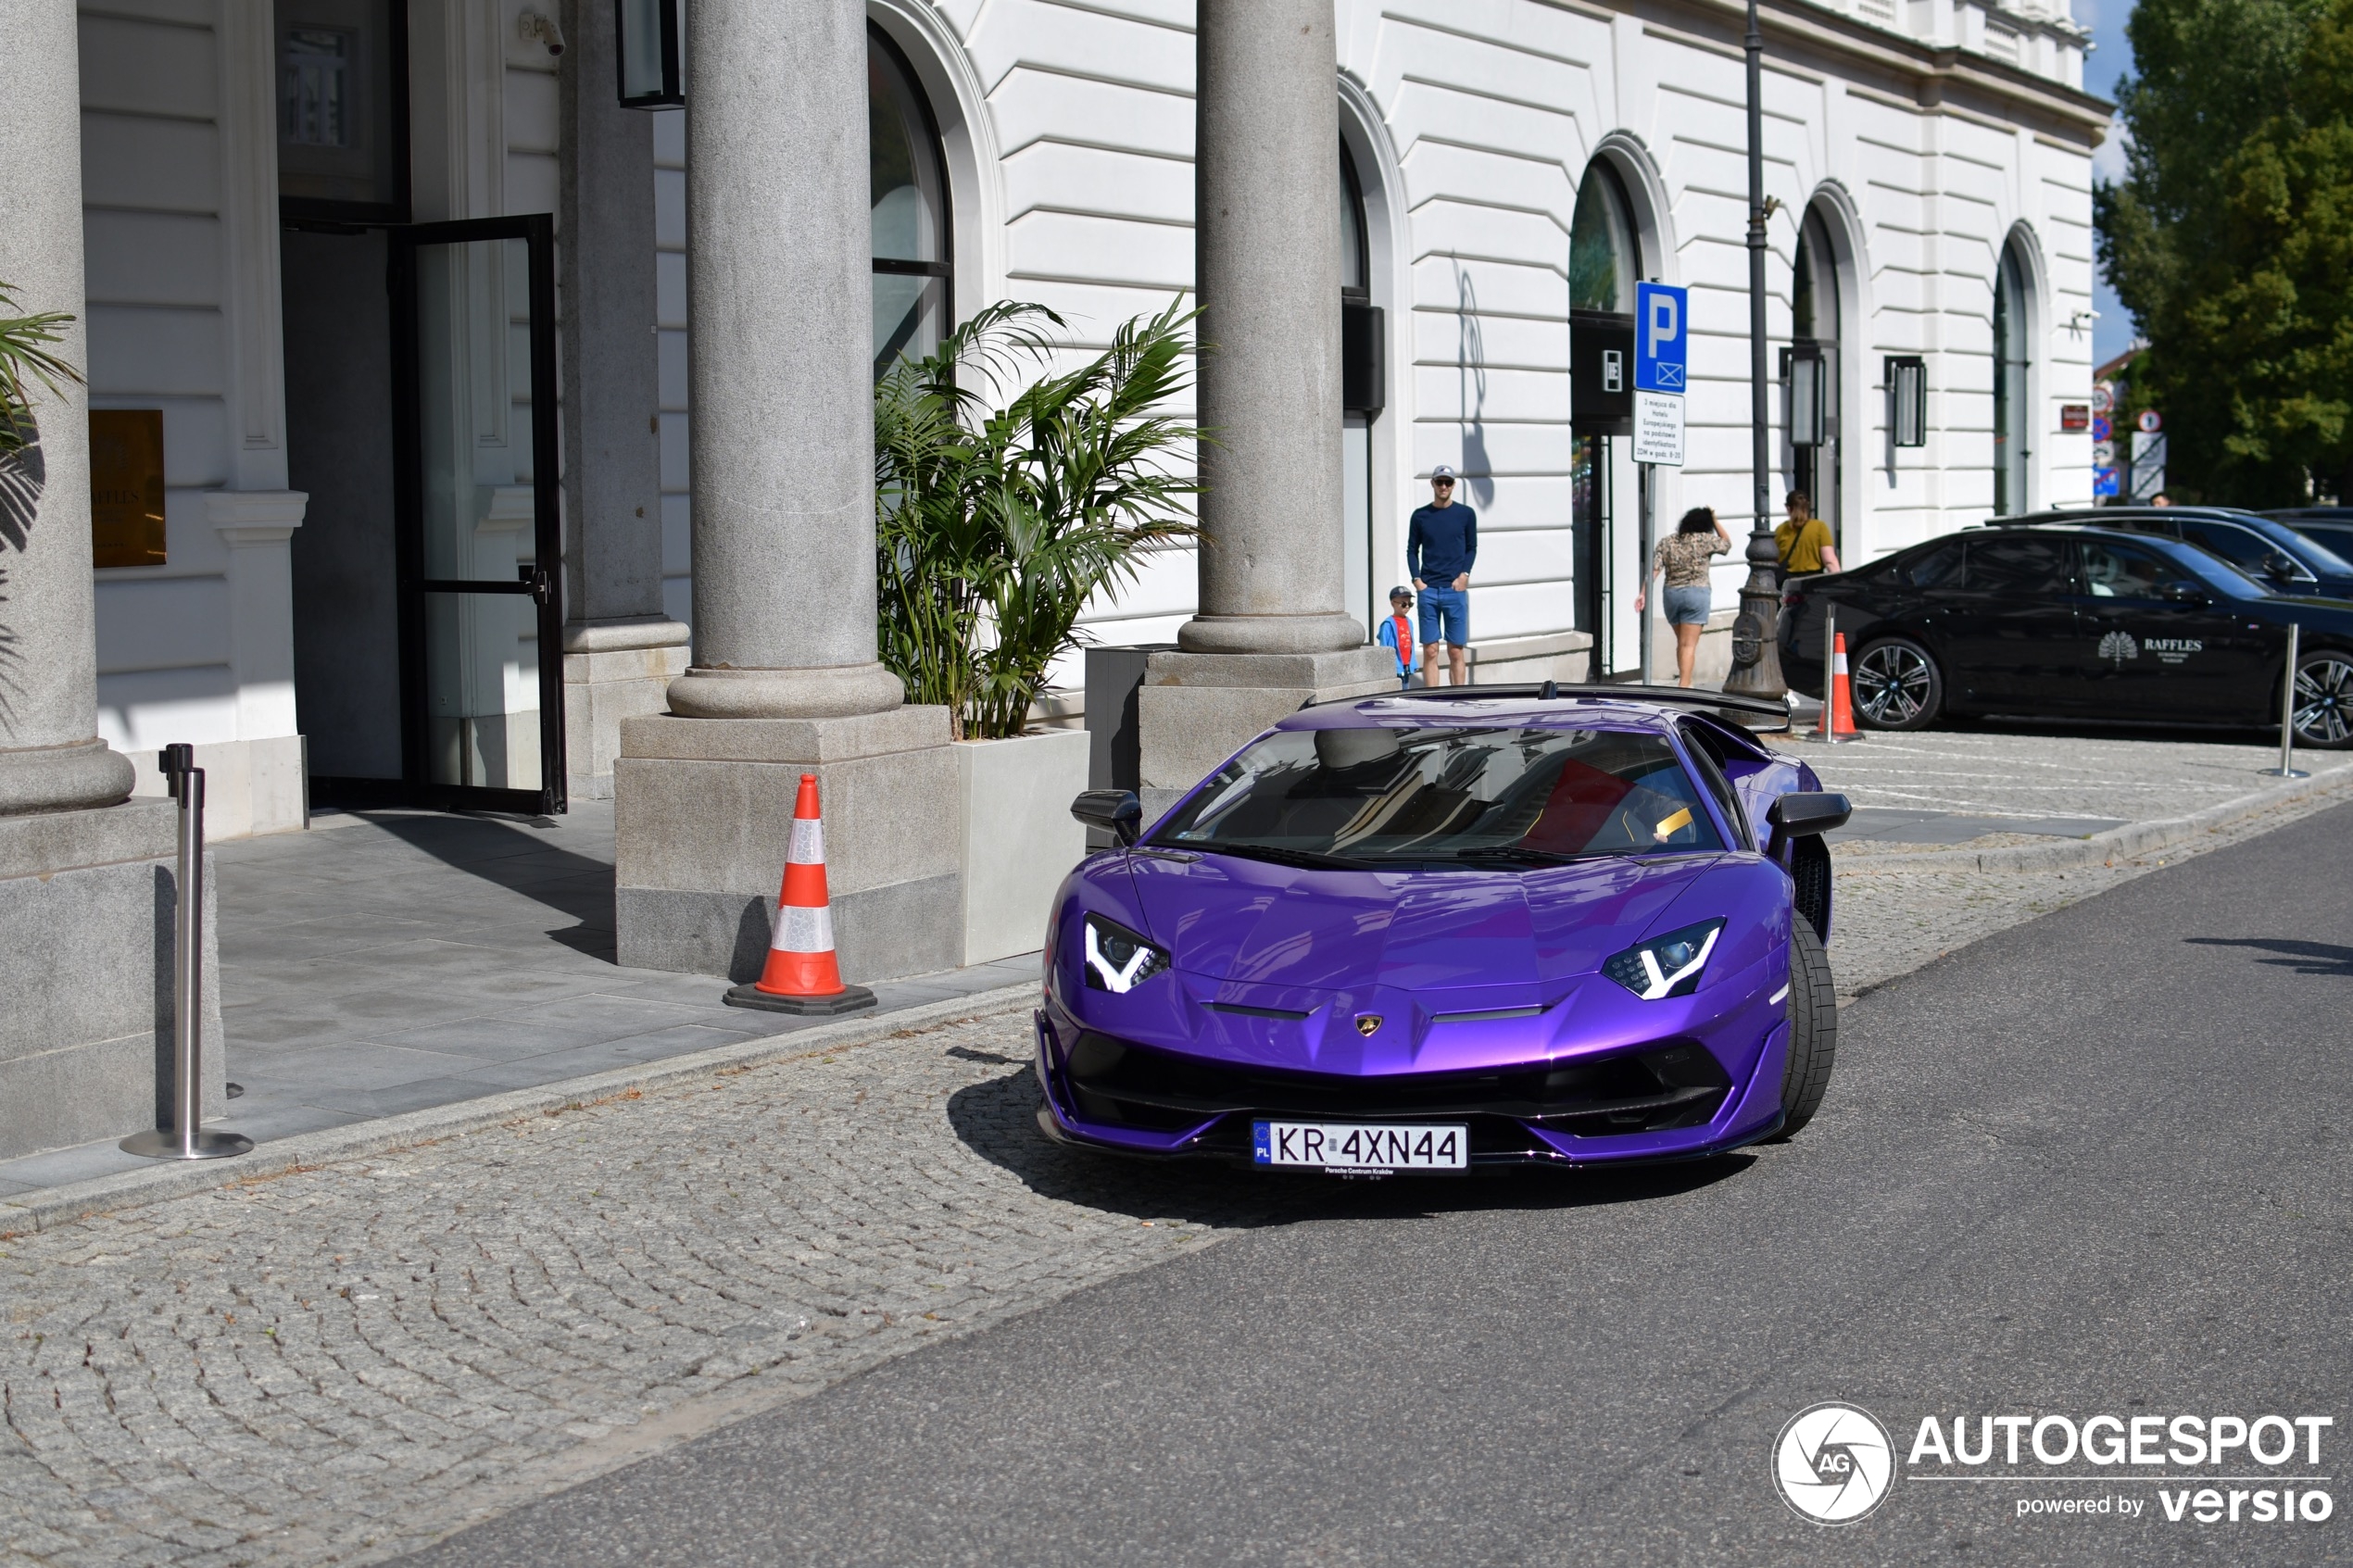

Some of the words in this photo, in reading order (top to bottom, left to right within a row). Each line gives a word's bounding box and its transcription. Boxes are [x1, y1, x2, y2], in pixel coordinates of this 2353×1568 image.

[1648, 293, 1678, 358] P
[1652, 409, 1668, 418] Hotelu
[1642, 418, 1677, 430] Europejskiego
[1651, 430, 1676, 439] podstawie
[1642, 438, 1677, 449] identyfikatora
[2145, 638, 2203, 652] RAFFLES
[1278, 1127, 1325, 1162] KR
[1341, 1129, 1456, 1164] 4XN44
[1256, 1148, 1269, 1158] PL
